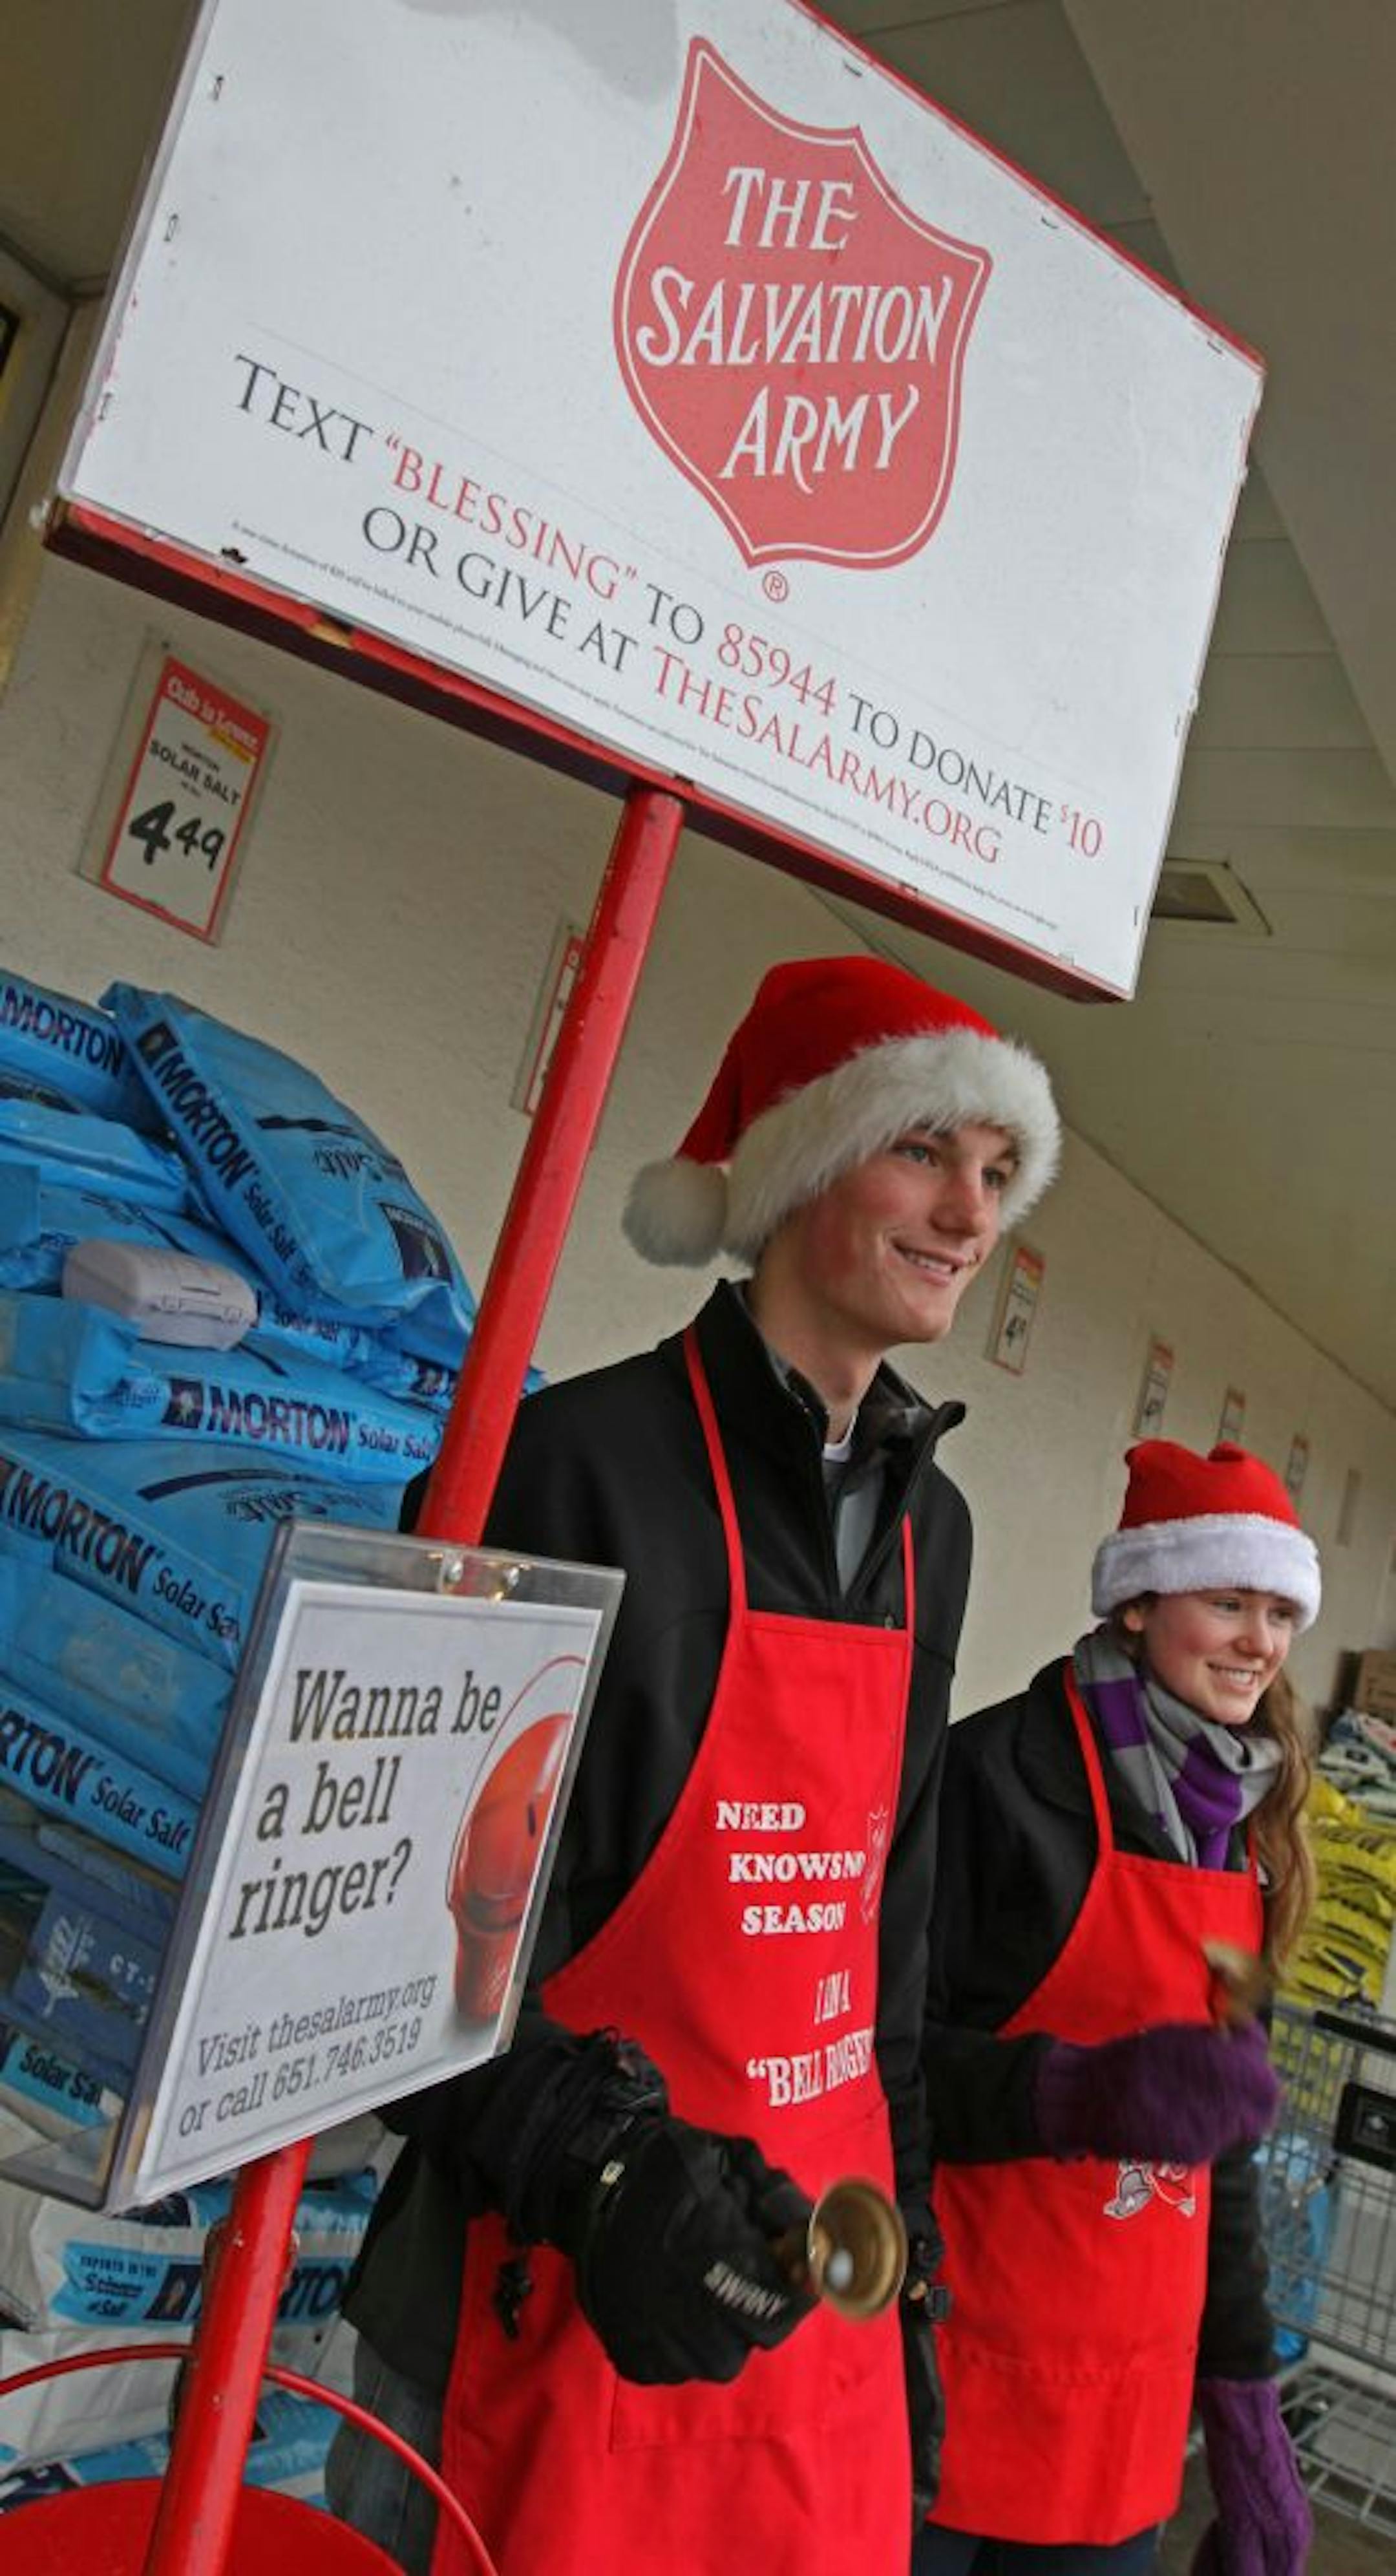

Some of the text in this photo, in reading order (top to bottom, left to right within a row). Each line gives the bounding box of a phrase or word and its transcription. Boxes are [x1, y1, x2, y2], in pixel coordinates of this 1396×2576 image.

[723, 165, 858, 250] THE
[636, 266, 953, 366] SALVATION
[719, 383, 920, 494] ARMY
[234, 354, 374, 463] TEXT
[648, 584, 704, 644] TO
[716, 623, 836, 718] 85944
[848, 693, 899, 749] TO
[907, 730, 1052, 835] DONATE
[1061, 803, 1103, 858] $10
[363, 507, 441, 579] OR
[458, 551, 571, 640] GIVE
[579, 619, 640, 675] AT
[149, 739, 200, 781] SOLAR
[202, 772, 242, 807] SALT
[0, 985, 127, 1078] MORTON
[155, 1052, 256, 1191] MORTON
[206, 1385, 352, 1454] MORTON
[5, 1464, 155, 1593] MORTON
[153, 1567, 206, 1621] Solar
[288, 1669, 500, 1744] Wanna be
[90, 1776, 145, 1829] Solar
[145, 1811, 191, 1857] Salt
[256, 1756, 402, 1841] a bell
[715, 1800, 805, 1832] NEED
[227, 1836, 414, 1939] ringer?
[729, 1851, 841, 1882] KNOWS
[742, 1900, 847, 1935] SEASON
[196, 1972, 437, 2078] Visit thesalarmy.org
[178, 2016, 424, 2138] or call 651.746.3519
